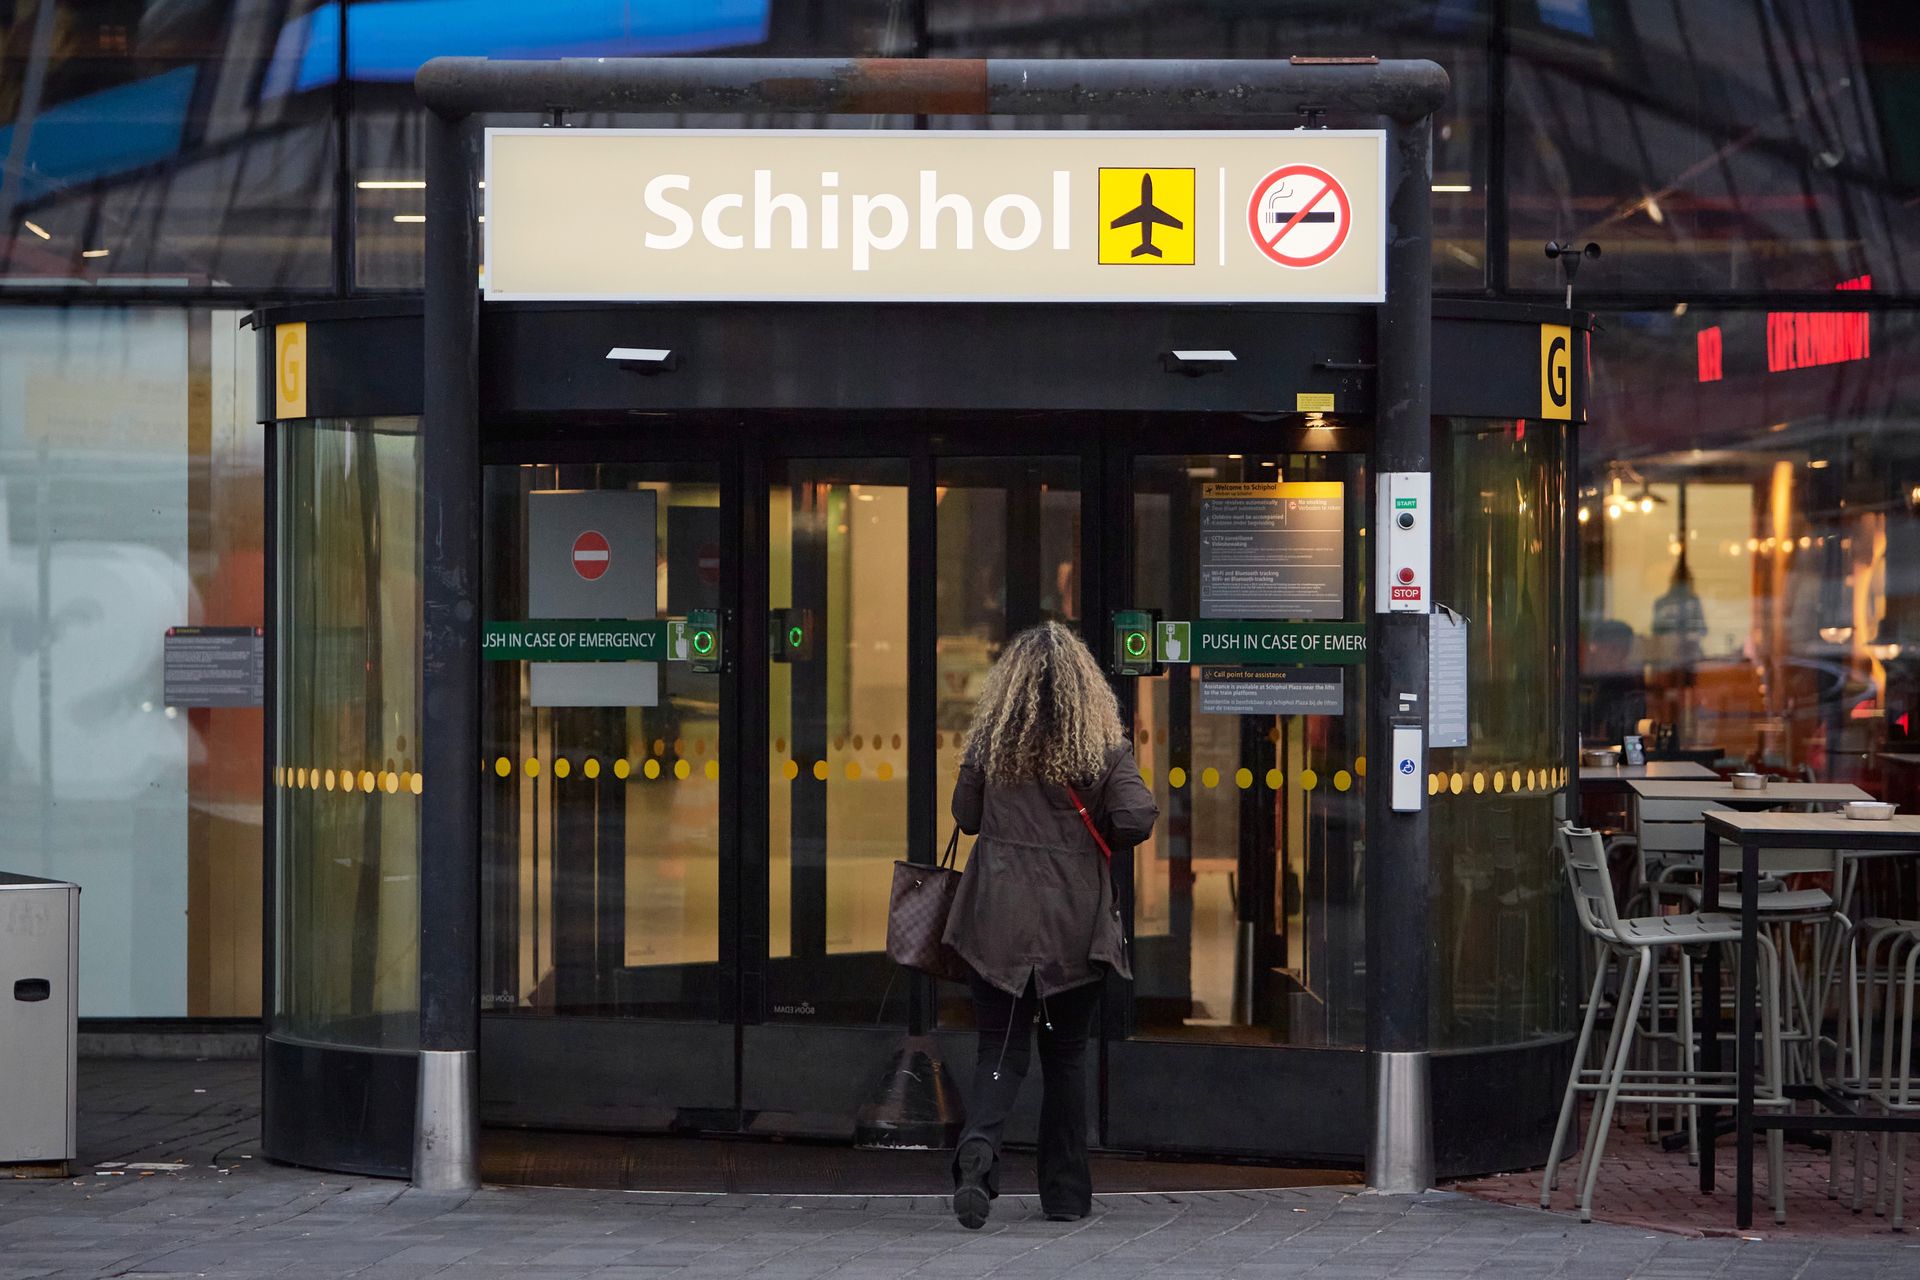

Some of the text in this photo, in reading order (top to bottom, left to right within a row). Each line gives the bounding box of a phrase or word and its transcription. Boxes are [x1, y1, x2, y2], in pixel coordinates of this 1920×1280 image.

[644, 169, 1070, 271] Schiphol
[280, 331, 300, 403] G
[1547, 336, 1567, 408] G
[1215, 483, 1277, 491] Welcome to Schiphol
[1393, 589, 1419, 598] STOP
[509, 633, 522, 648] IN
[524, 633, 556, 648] CASE
[558, 632, 575, 647] OF
[579, 632, 656, 648] EMERGENCY
[1202, 633, 1240, 649] PUSH
[1243, 634, 1258, 649] IN
[1261, 634, 1298, 650] CASE
[1300, 634, 1321, 650] OF
[1213, 671, 1286, 679] Call point for assistance
